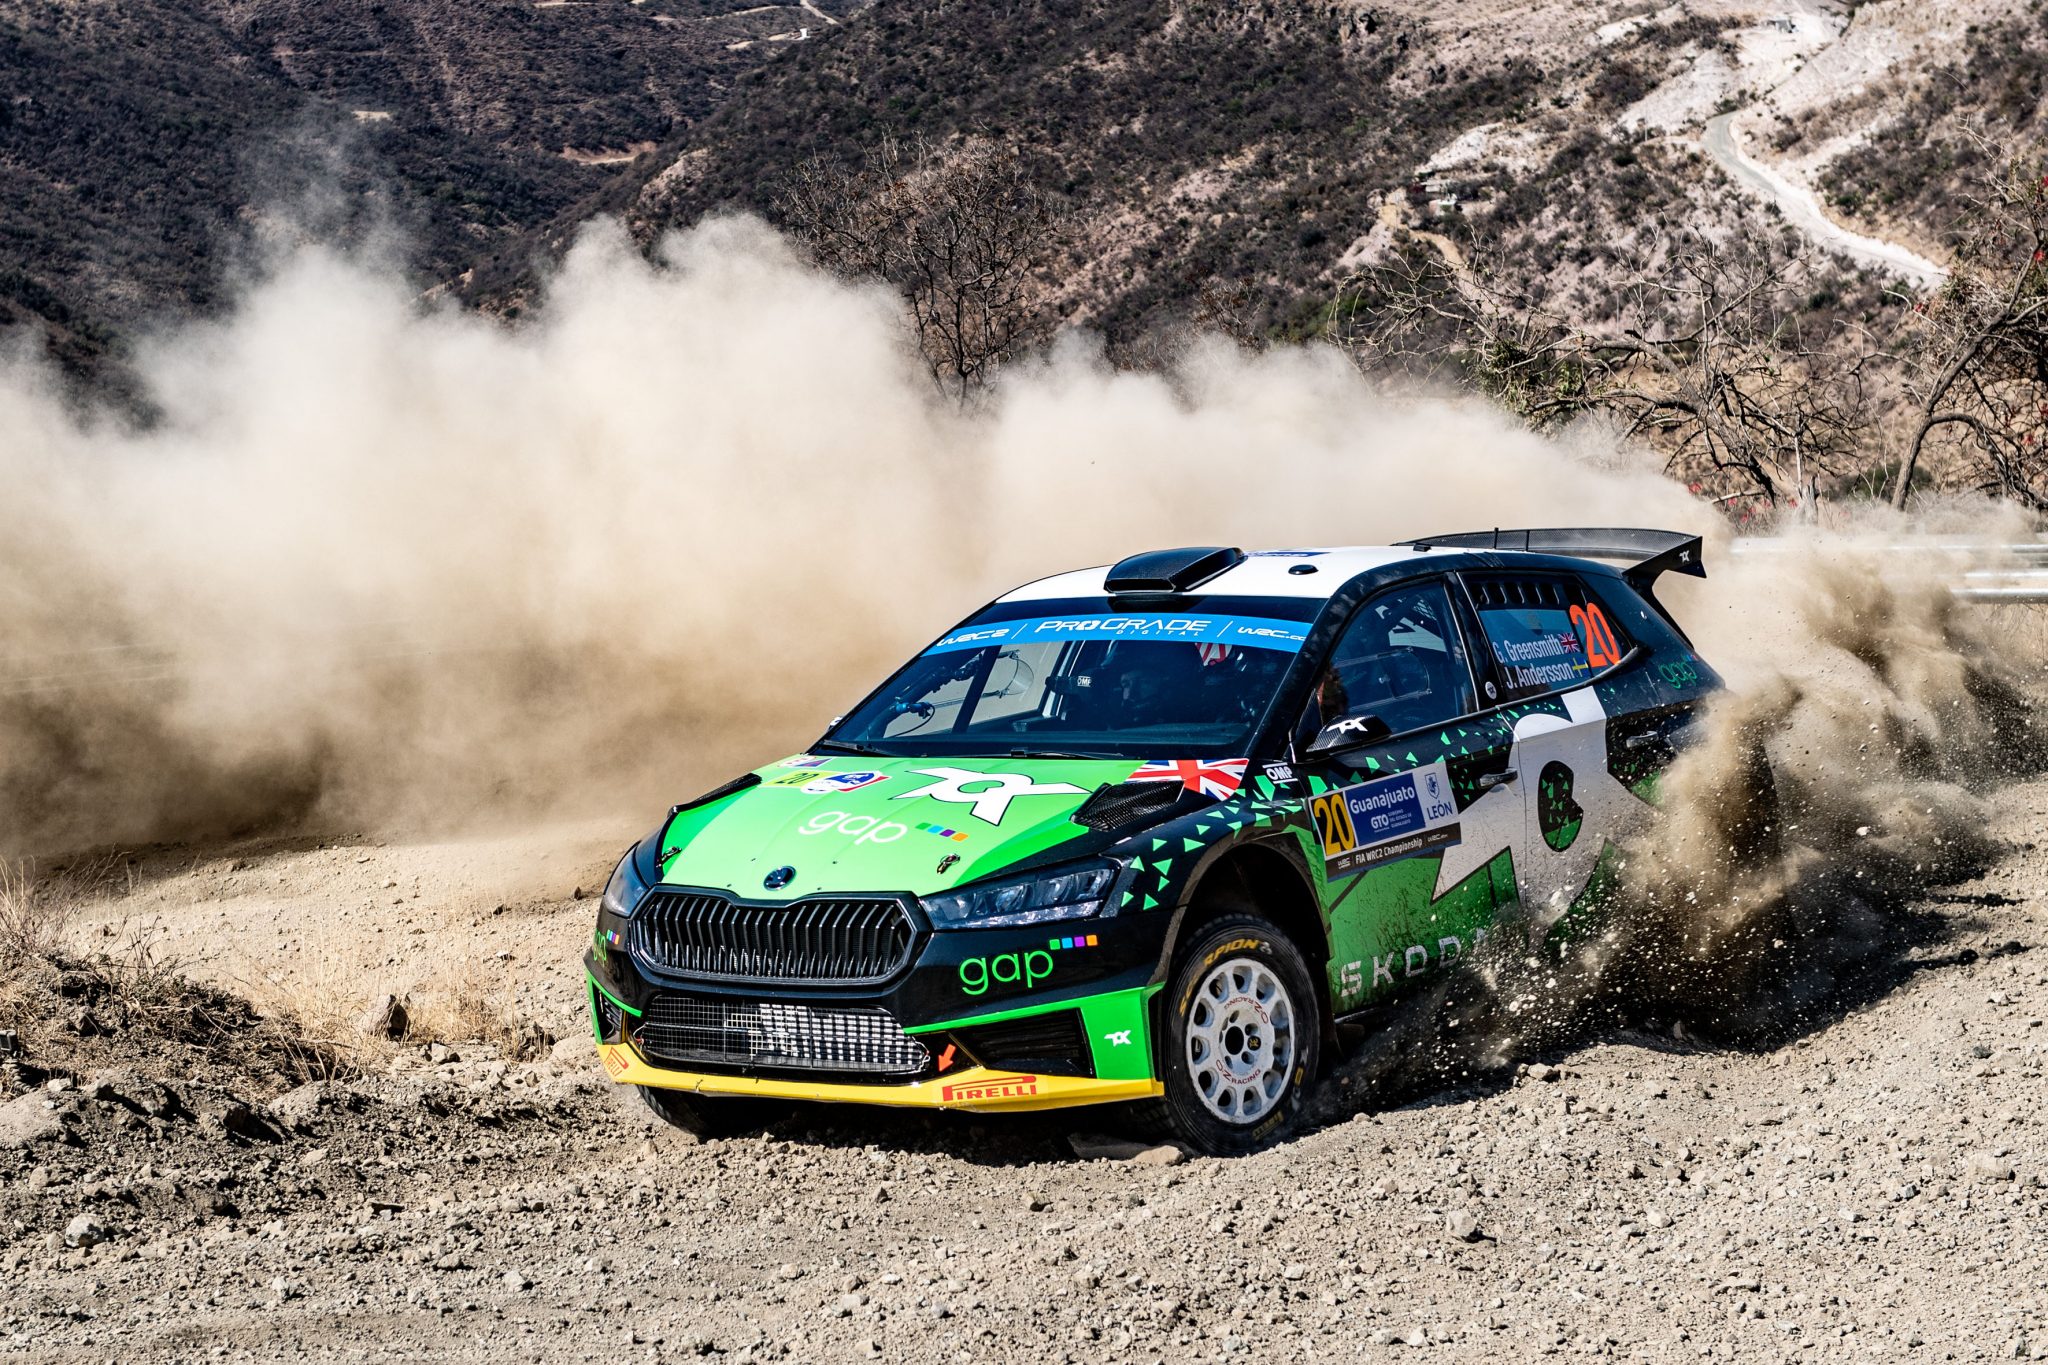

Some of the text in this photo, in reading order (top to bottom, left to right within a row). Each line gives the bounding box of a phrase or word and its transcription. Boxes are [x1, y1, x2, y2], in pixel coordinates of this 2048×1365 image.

[936, 628, 1010, 647] WRC2
[1116, 629, 1199, 637] DIGITAL
[1569, 602, 1621, 668] 20
[1492, 633, 1565, 664] G. Greensmith
[1504, 661, 1575, 690] J. Andersson
[1266, 765, 1293, 782] OMP
[1350, 786, 1416, 815] Guanajuato
[1427, 802, 1454, 820] LEÓN
[798, 810, 908, 845] gap
[1313, 793, 1355, 856] 20
[1371, 813, 1389, 830] GTO
[1355, 853, 1366, 865] FIA
[1366, 848, 1383, 861] WRC2
[1383, 837, 1423, 856] Championship
[959, 950, 1054, 996] gap
[942, 1075, 1037, 1102] PIRELLI
[1231, 1068, 1261, 1085] RACING
